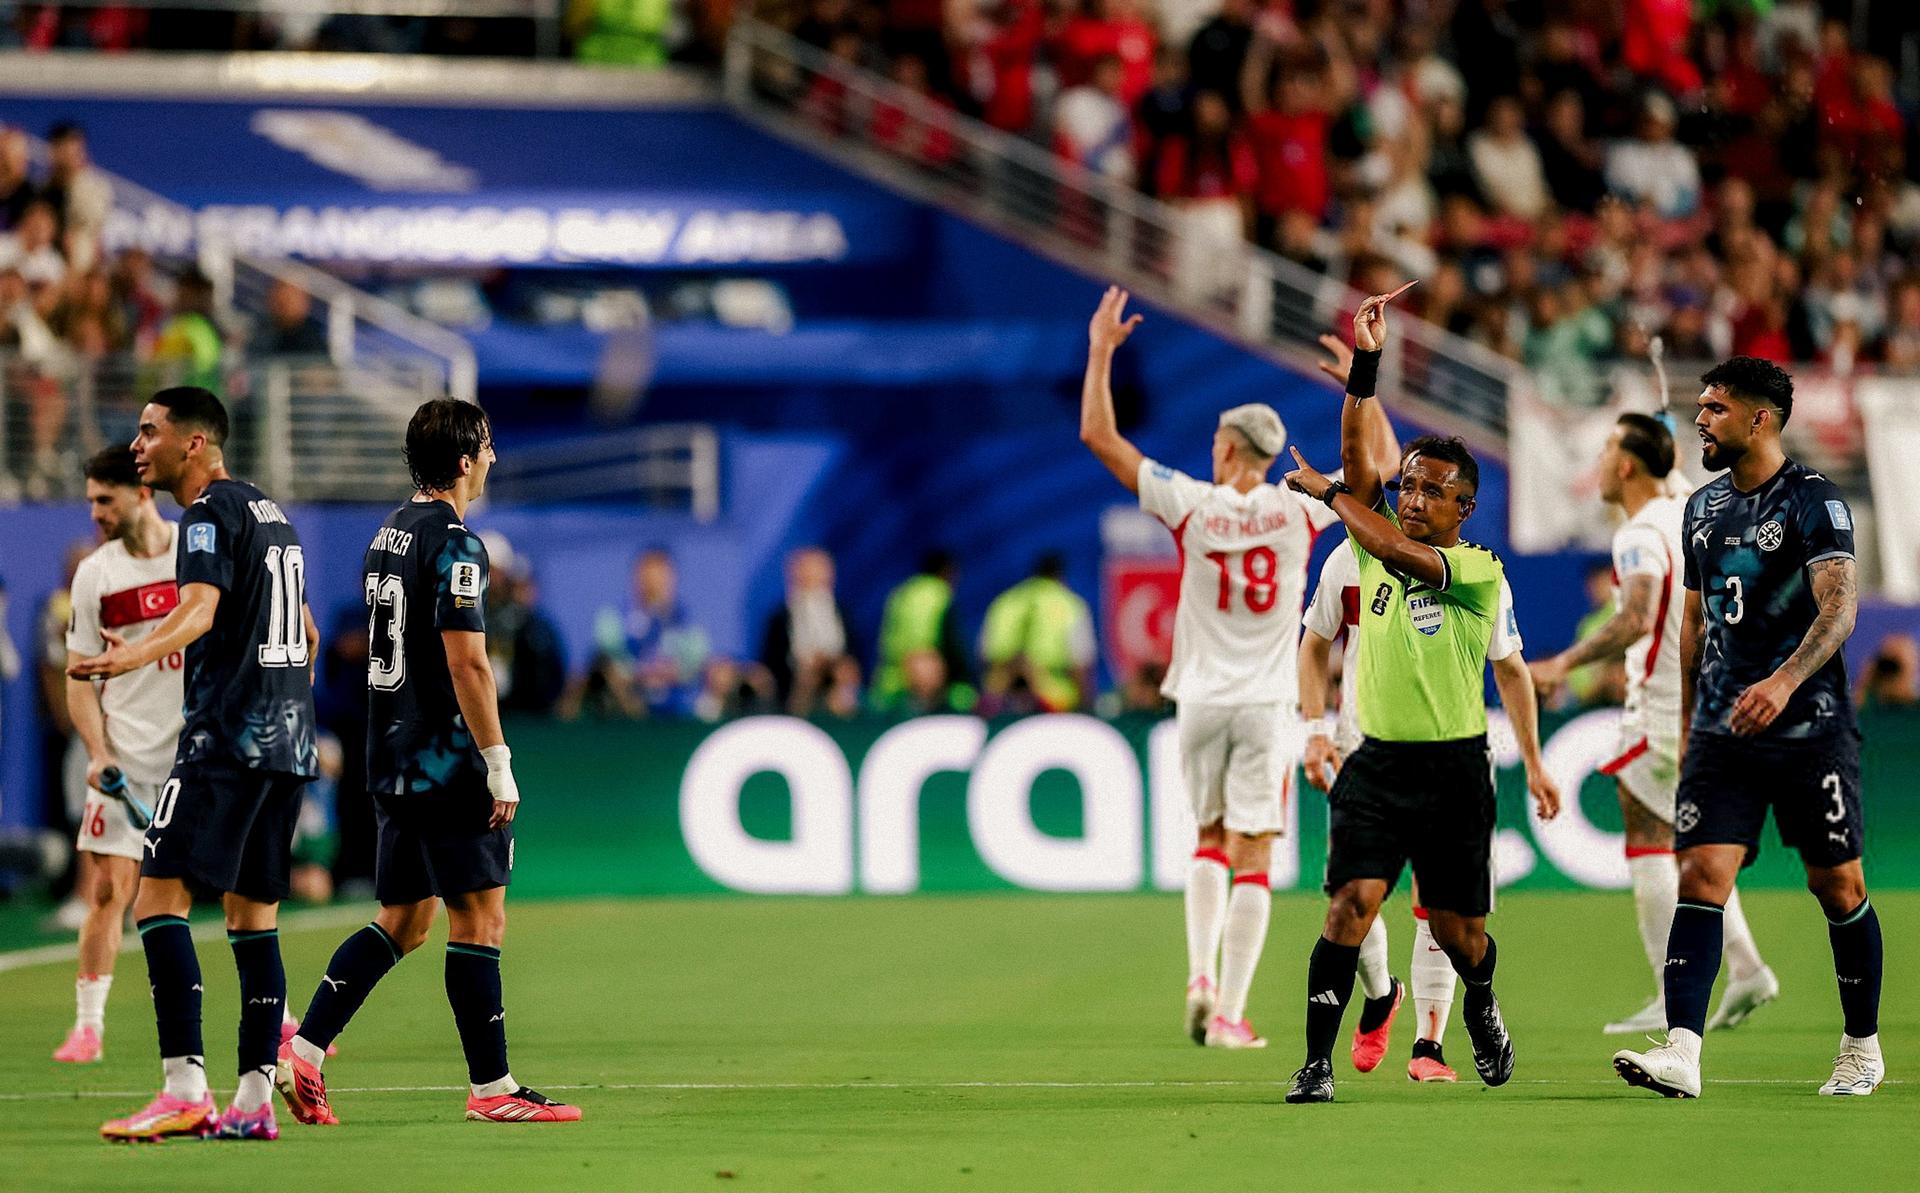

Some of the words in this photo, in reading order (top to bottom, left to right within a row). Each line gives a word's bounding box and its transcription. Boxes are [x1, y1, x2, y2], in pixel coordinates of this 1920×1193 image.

[1205, 546, 1277, 615] 18
[1410, 595, 1439, 610] FIFA
[1725, 576, 1744, 625] 3
[258, 545, 309, 668] 10
[1413, 611, 1442, 622] REFEREE
[84, 802, 106, 838] 16
[1822, 773, 1846, 824] 3
